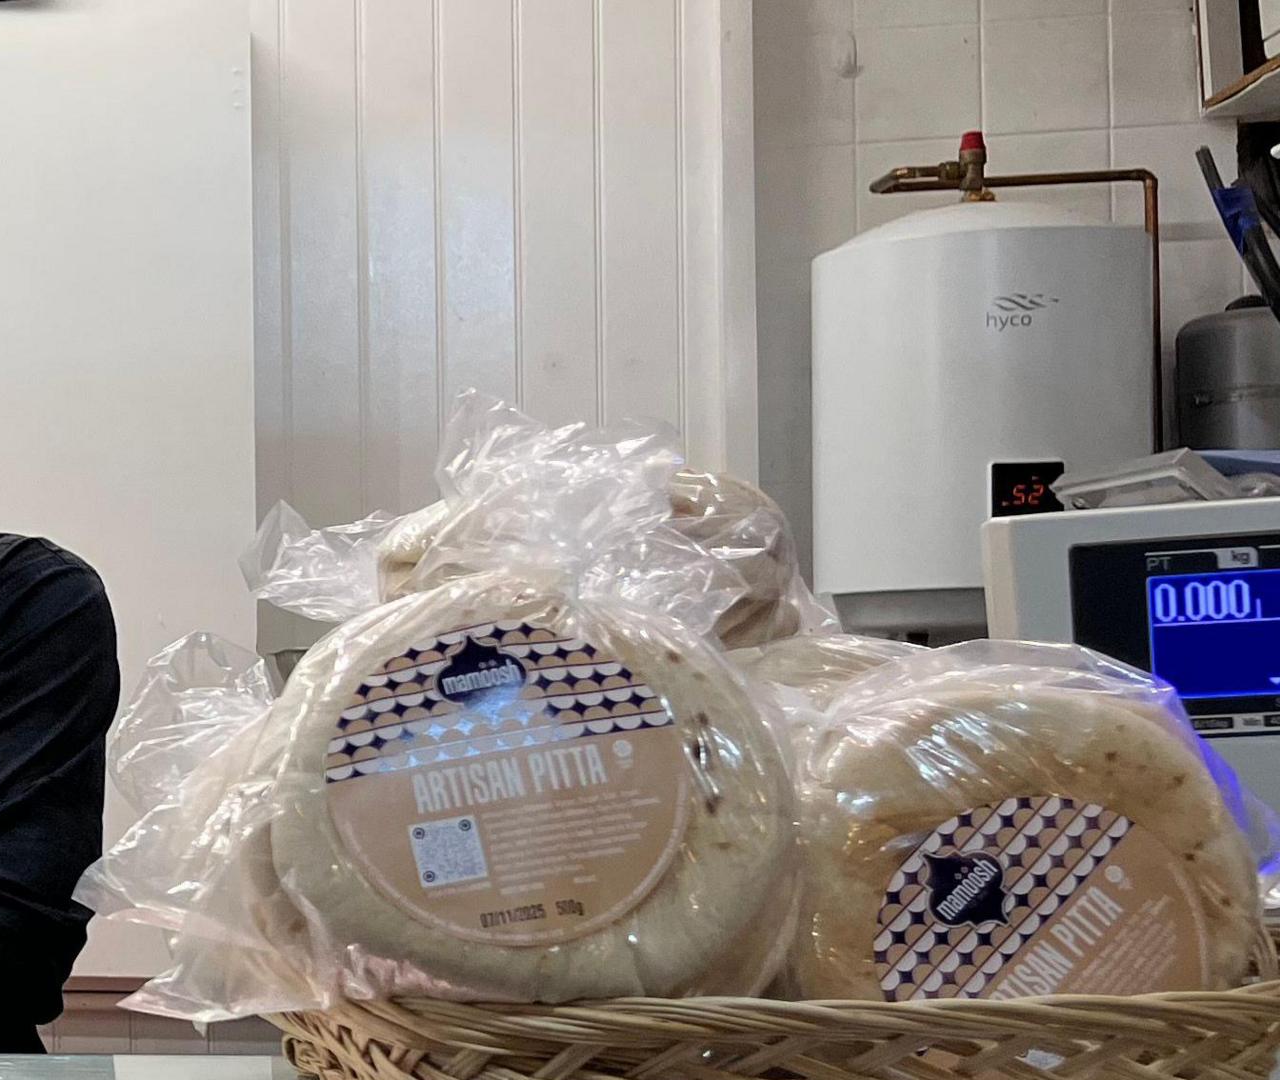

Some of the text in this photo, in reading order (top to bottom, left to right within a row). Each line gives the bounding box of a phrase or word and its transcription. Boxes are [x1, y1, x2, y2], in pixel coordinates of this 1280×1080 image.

[986, 312, 1032, 331] hyco
[1146, 550, 1250, 571] PT kg
[1155, 580, 1251, 622] 0.000
[411, 744, 608, 814] ARTISAN PITTA
[1050, 886, 1124, 964] PITTA
